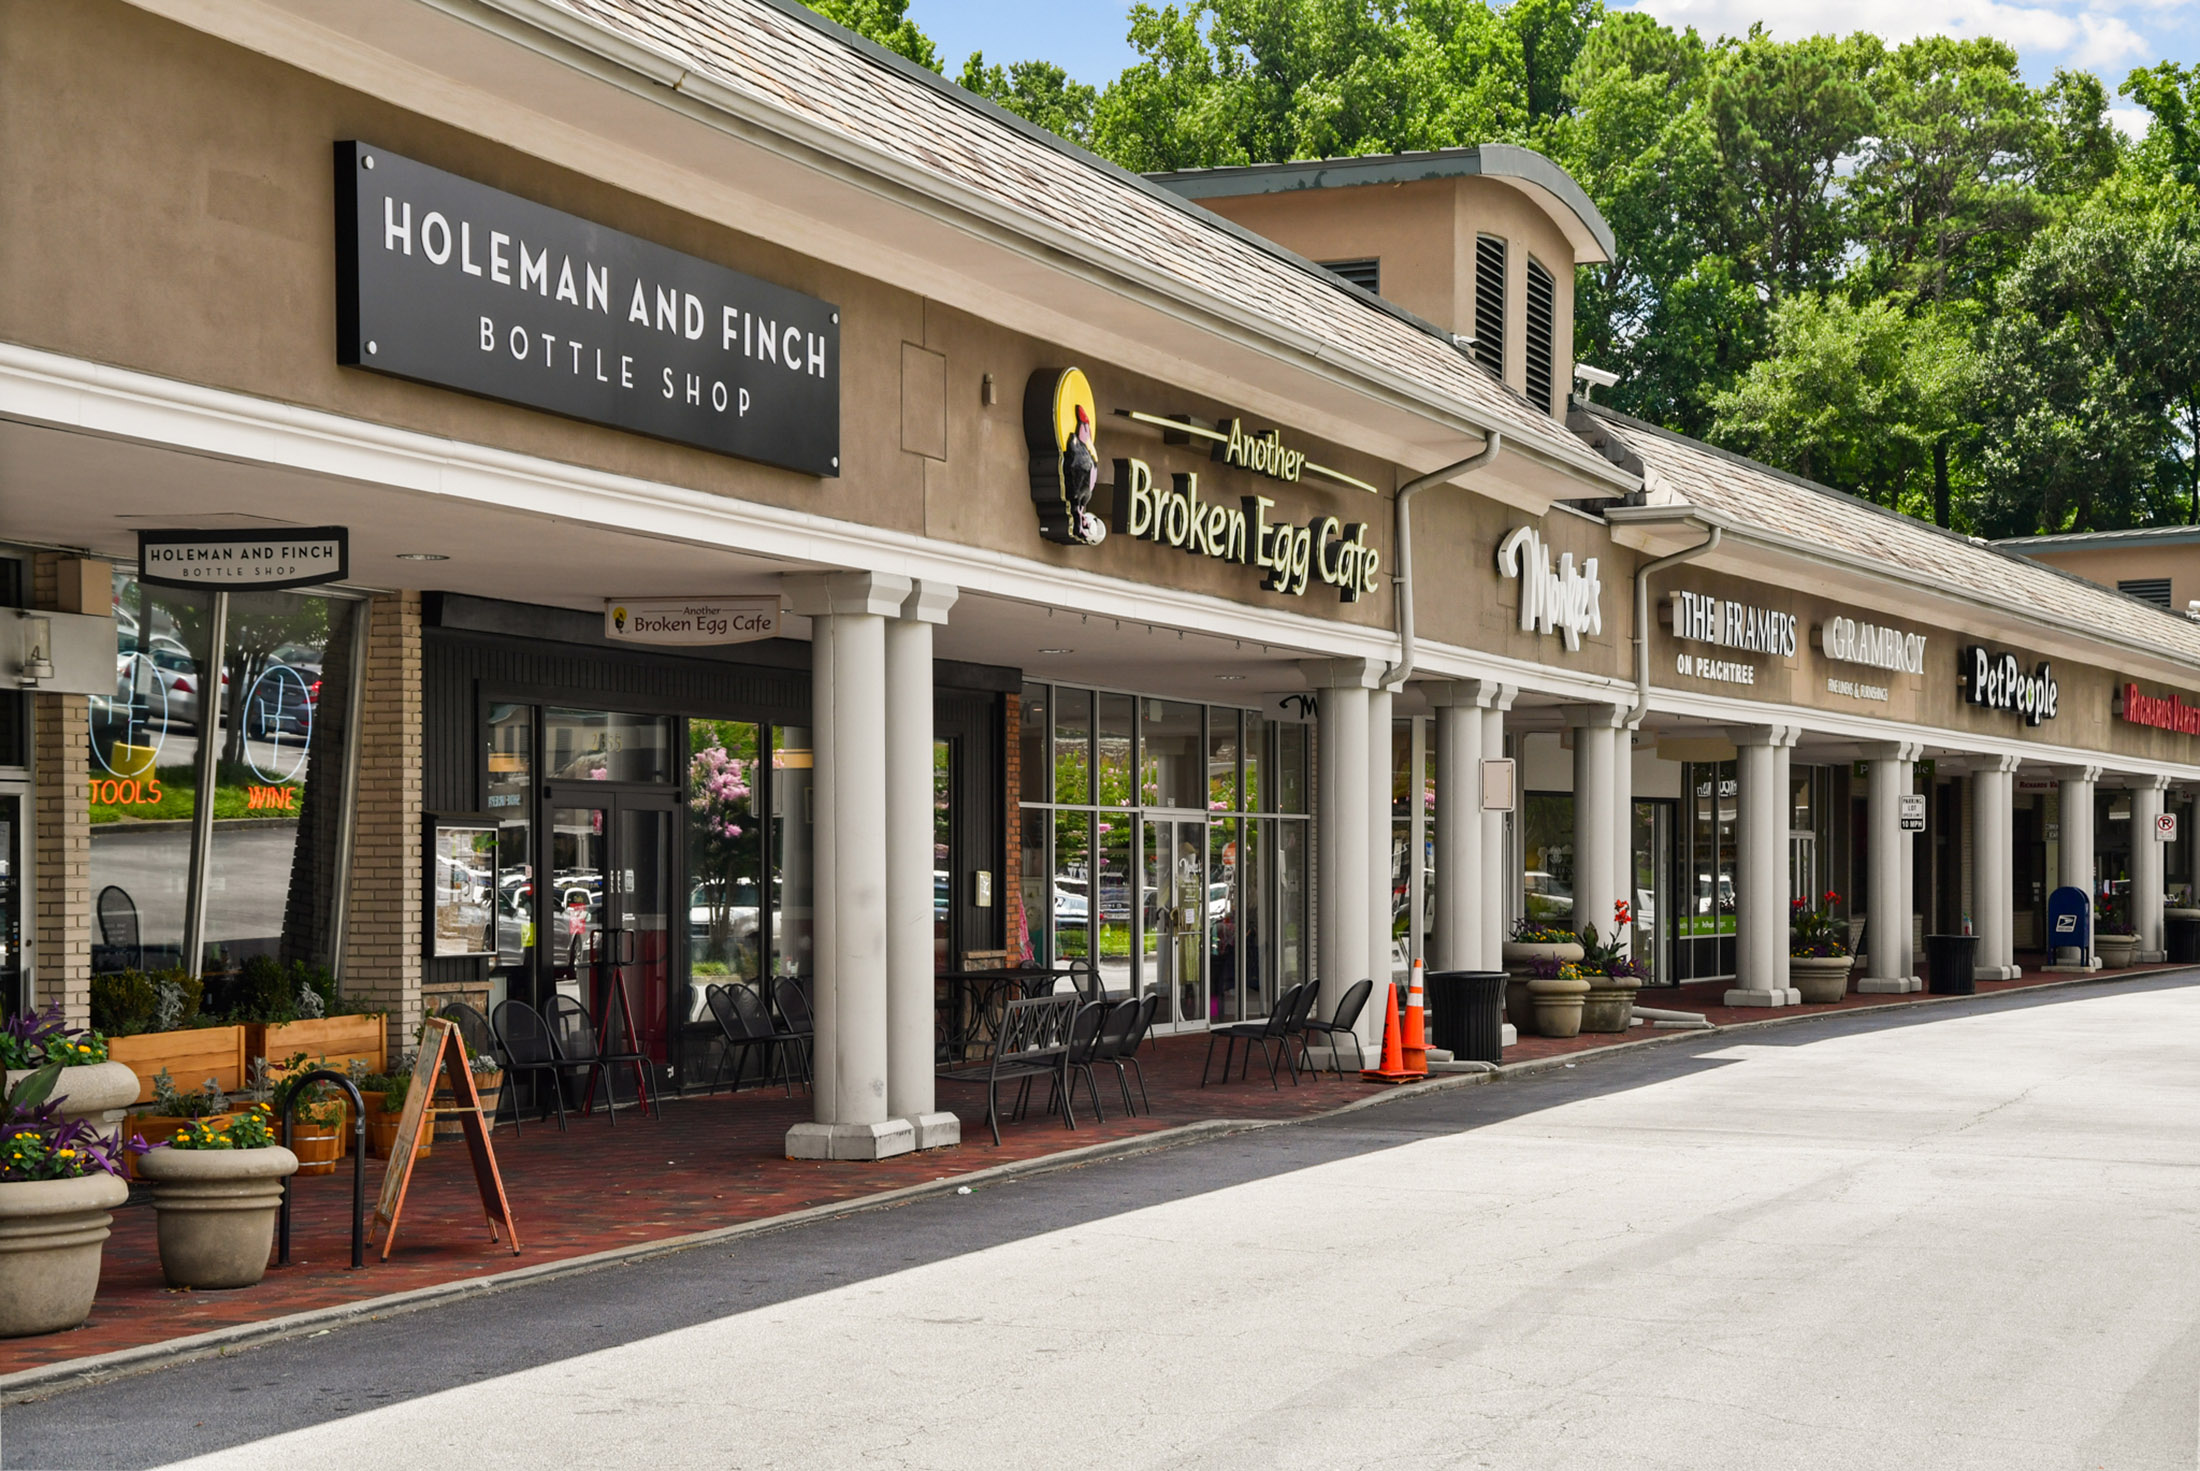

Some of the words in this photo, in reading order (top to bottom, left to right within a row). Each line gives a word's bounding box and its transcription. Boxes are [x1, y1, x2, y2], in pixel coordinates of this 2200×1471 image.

[384, 196, 609, 315] HOLEMAN
[628, 277, 705, 341] AND
[722, 304, 826, 379] FINCH
[480, 316, 634, 389] BOTTLE
[662, 367, 751, 417] SHOP
[1225, 417, 1305, 483] Another
[1128, 457, 1246, 564] Broken
[1255, 495, 1311, 596] Egg
[1316, 516, 1380, 603] Cafe
[151, 548, 232, 562] HOLEMAN
[240, 546, 274, 561] AND
[282, 545, 333, 559] FINCH
[183, 567, 243, 577] BOTTLE
[255, 566, 296, 576] SHOP
[635, 616, 691, 632] Broken
[697, 616, 728, 635] Egg
[733, 614, 771, 633] Cafe
[683, 606, 721, 616] Another
[1680, 590, 1715, 643] THE
[1723, 601, 1797, 658] FRAMERS
[1831, 615, 1927, 674] GRAMERCY
[1677, 653, 1693, 675] ON
[1696, 657, 1754, 684] PEACHTREE
[1974, 647, 2058, 725] PetPeople
[88, 779, 162, 804] TOOLS
[248, 786, 296, 809] WINE
